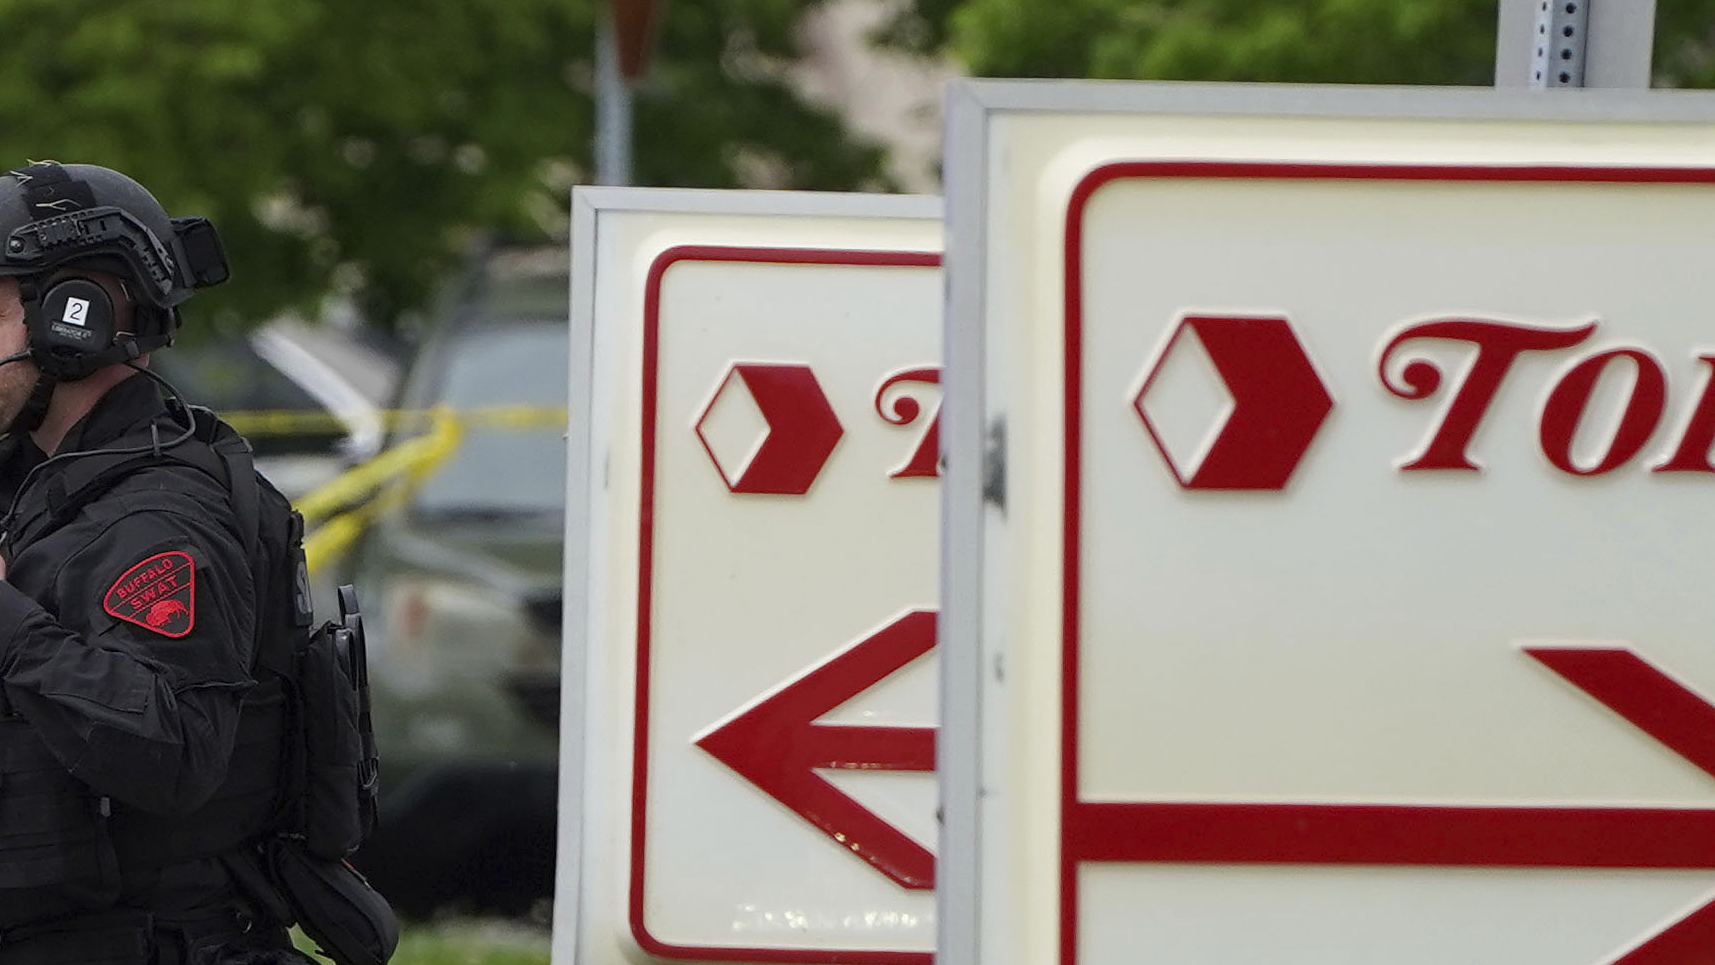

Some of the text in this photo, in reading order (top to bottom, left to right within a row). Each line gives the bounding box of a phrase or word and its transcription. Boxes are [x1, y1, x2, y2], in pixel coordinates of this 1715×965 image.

[69, 302, 84, 321] 2
[116, 558, 174, 599] BUFFALO
[130, 574, 179, 610] SWAT
